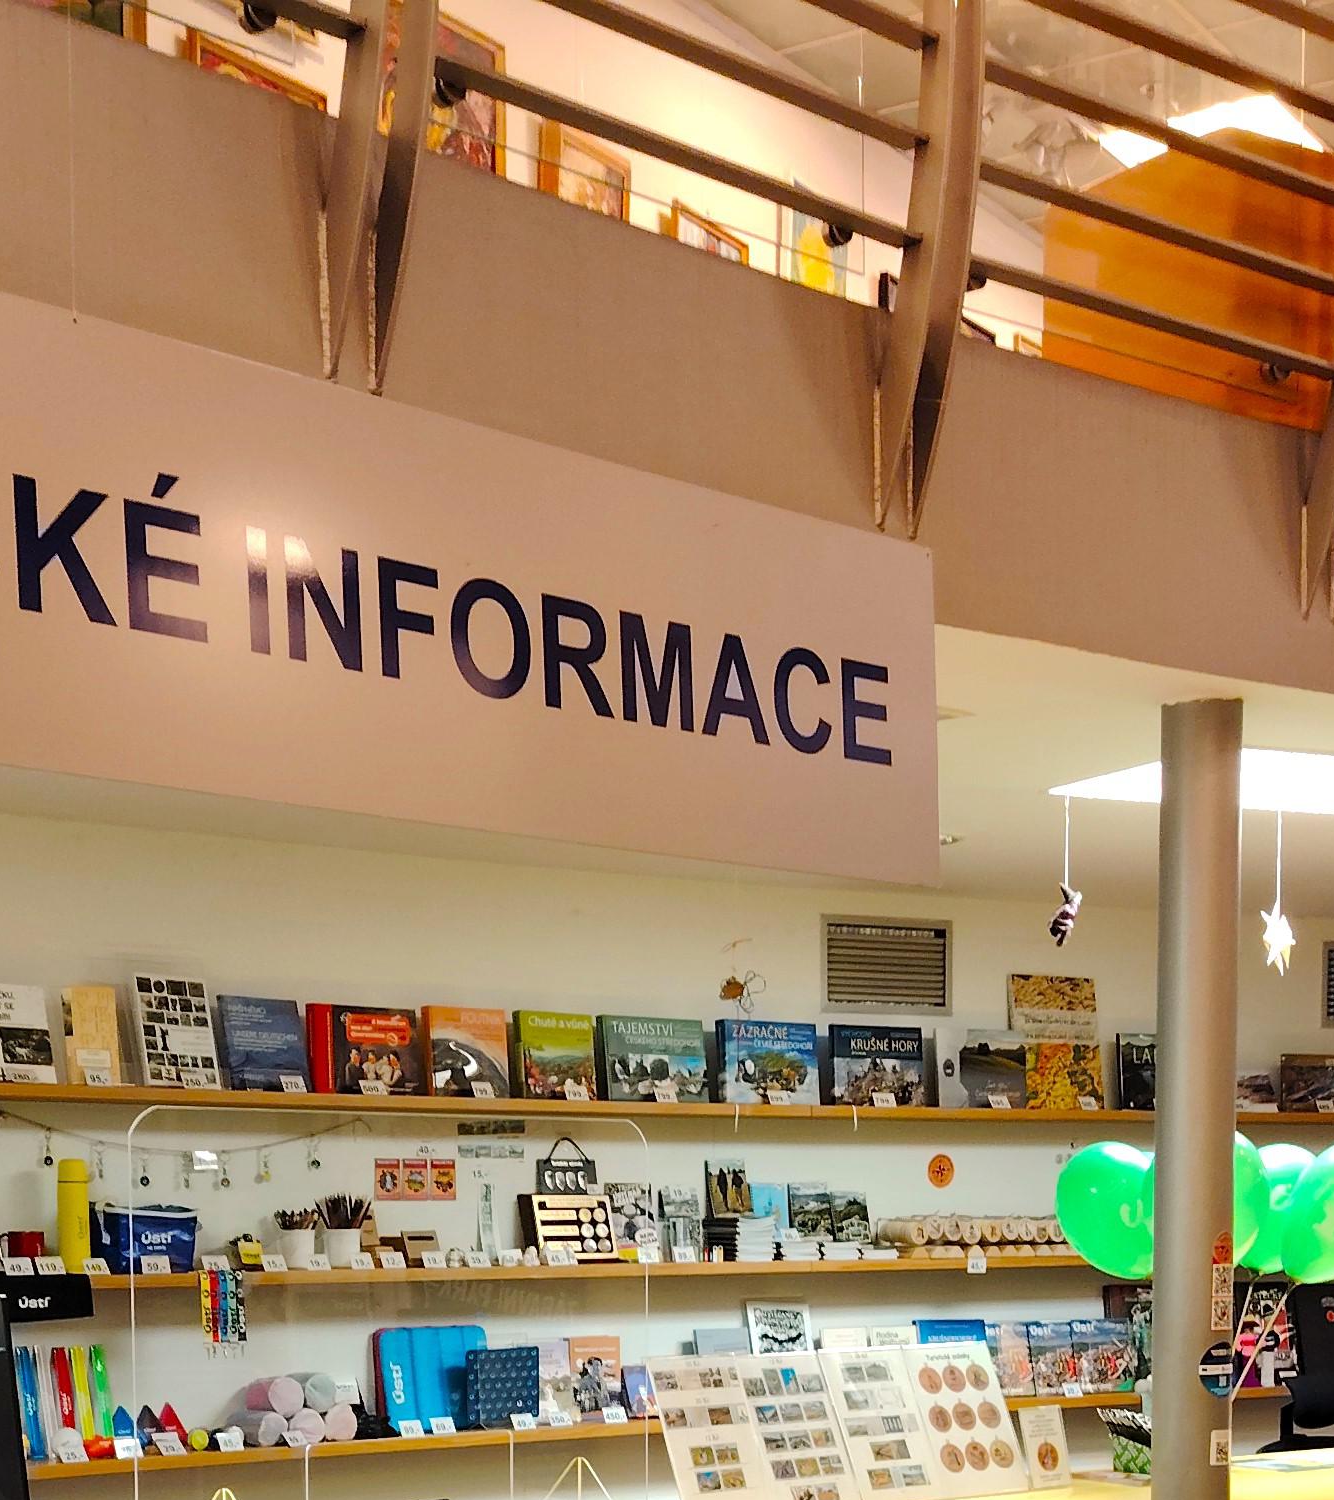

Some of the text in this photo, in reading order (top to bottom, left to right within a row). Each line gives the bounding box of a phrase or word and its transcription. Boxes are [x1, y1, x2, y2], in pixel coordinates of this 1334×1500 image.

[246, 523, 893, 766] INFORMACE
[528, 1015, 556, 1029] Chutě
[566, 1018, 589, 1030] vůně
[611, 1019, 674, 1037] TAJEMSTVÍ
[732, 1022, 788, 1040] ZÁZRAČNÉ
[656, 1036, 701, 1048] STŘEDOHOŘÍ
[850, 1037, 919, 1054] KRUŠNÉ HORY
[1132, 1046, 1156, 1065] LA
[140, 1230, 174, 1246] Ústí
[17, 1295, 52, 1309] Ústí
